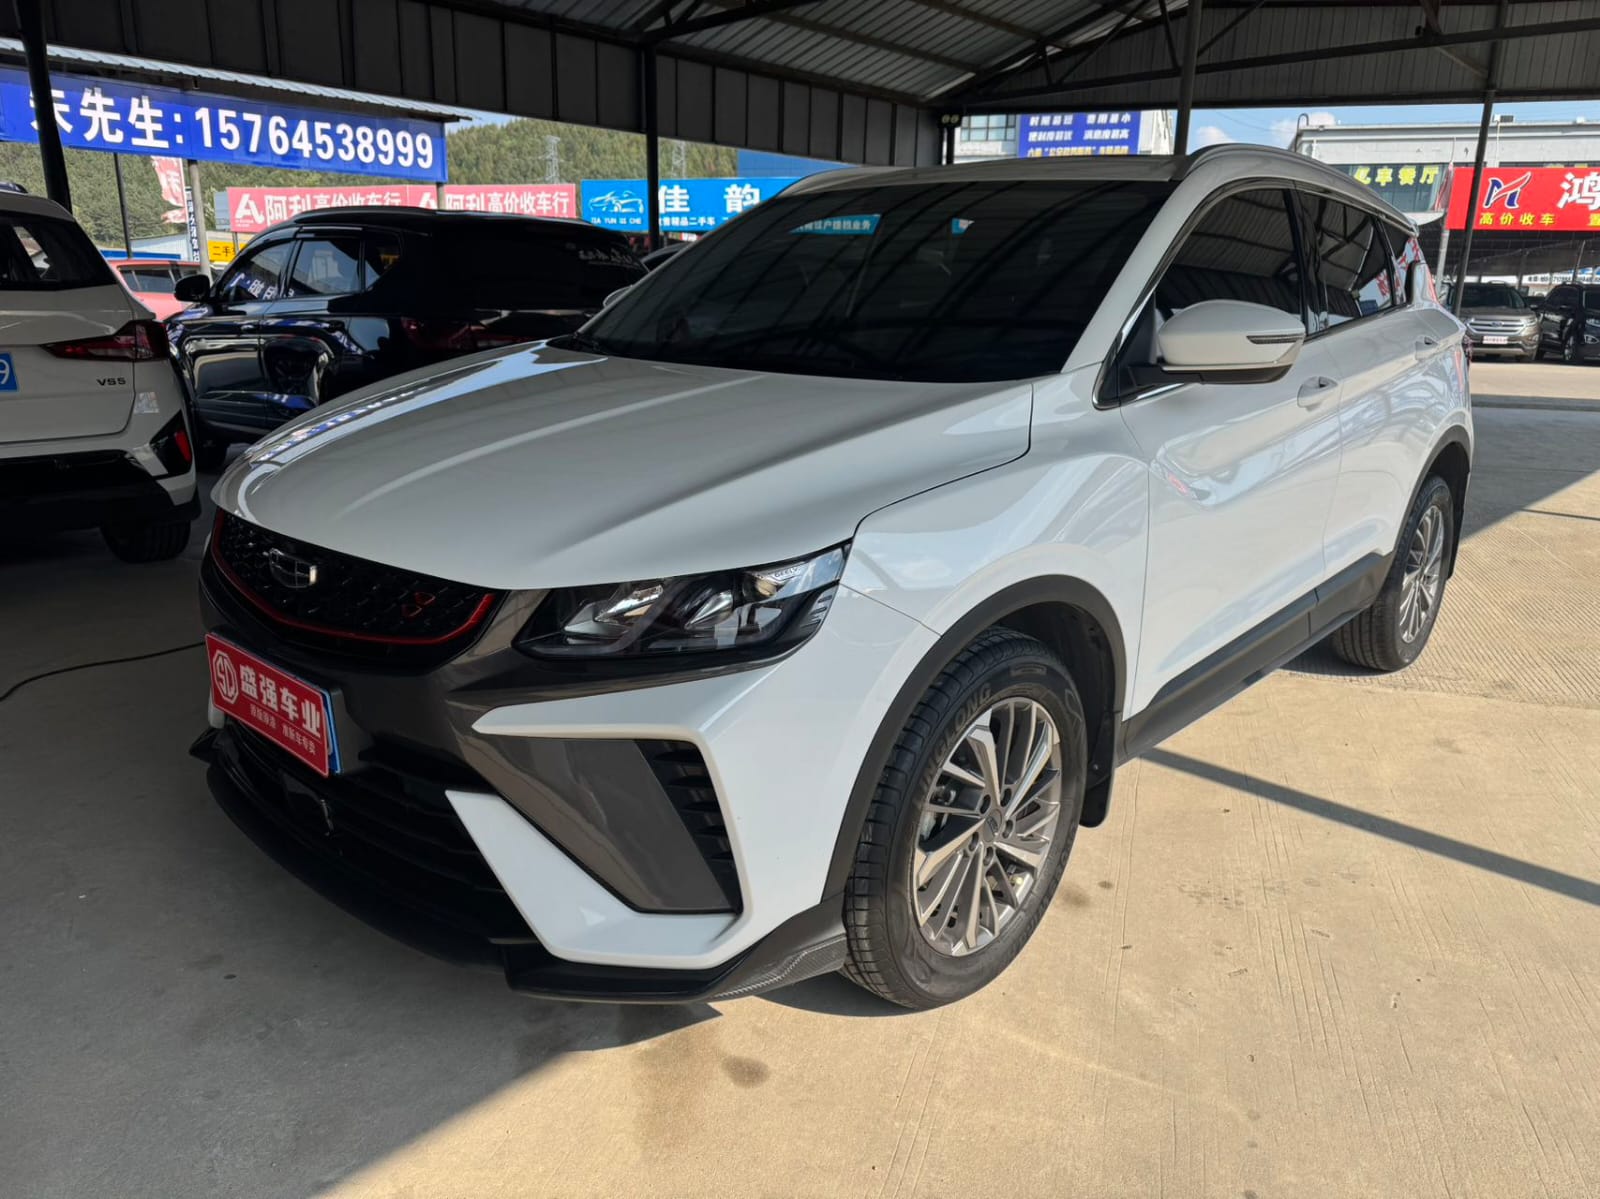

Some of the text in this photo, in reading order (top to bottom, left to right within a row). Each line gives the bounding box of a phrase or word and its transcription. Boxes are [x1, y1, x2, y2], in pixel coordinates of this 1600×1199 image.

[1479, 212, 1555, 226] 高价收车
[240, 663, 321, 738] 盛强车业
